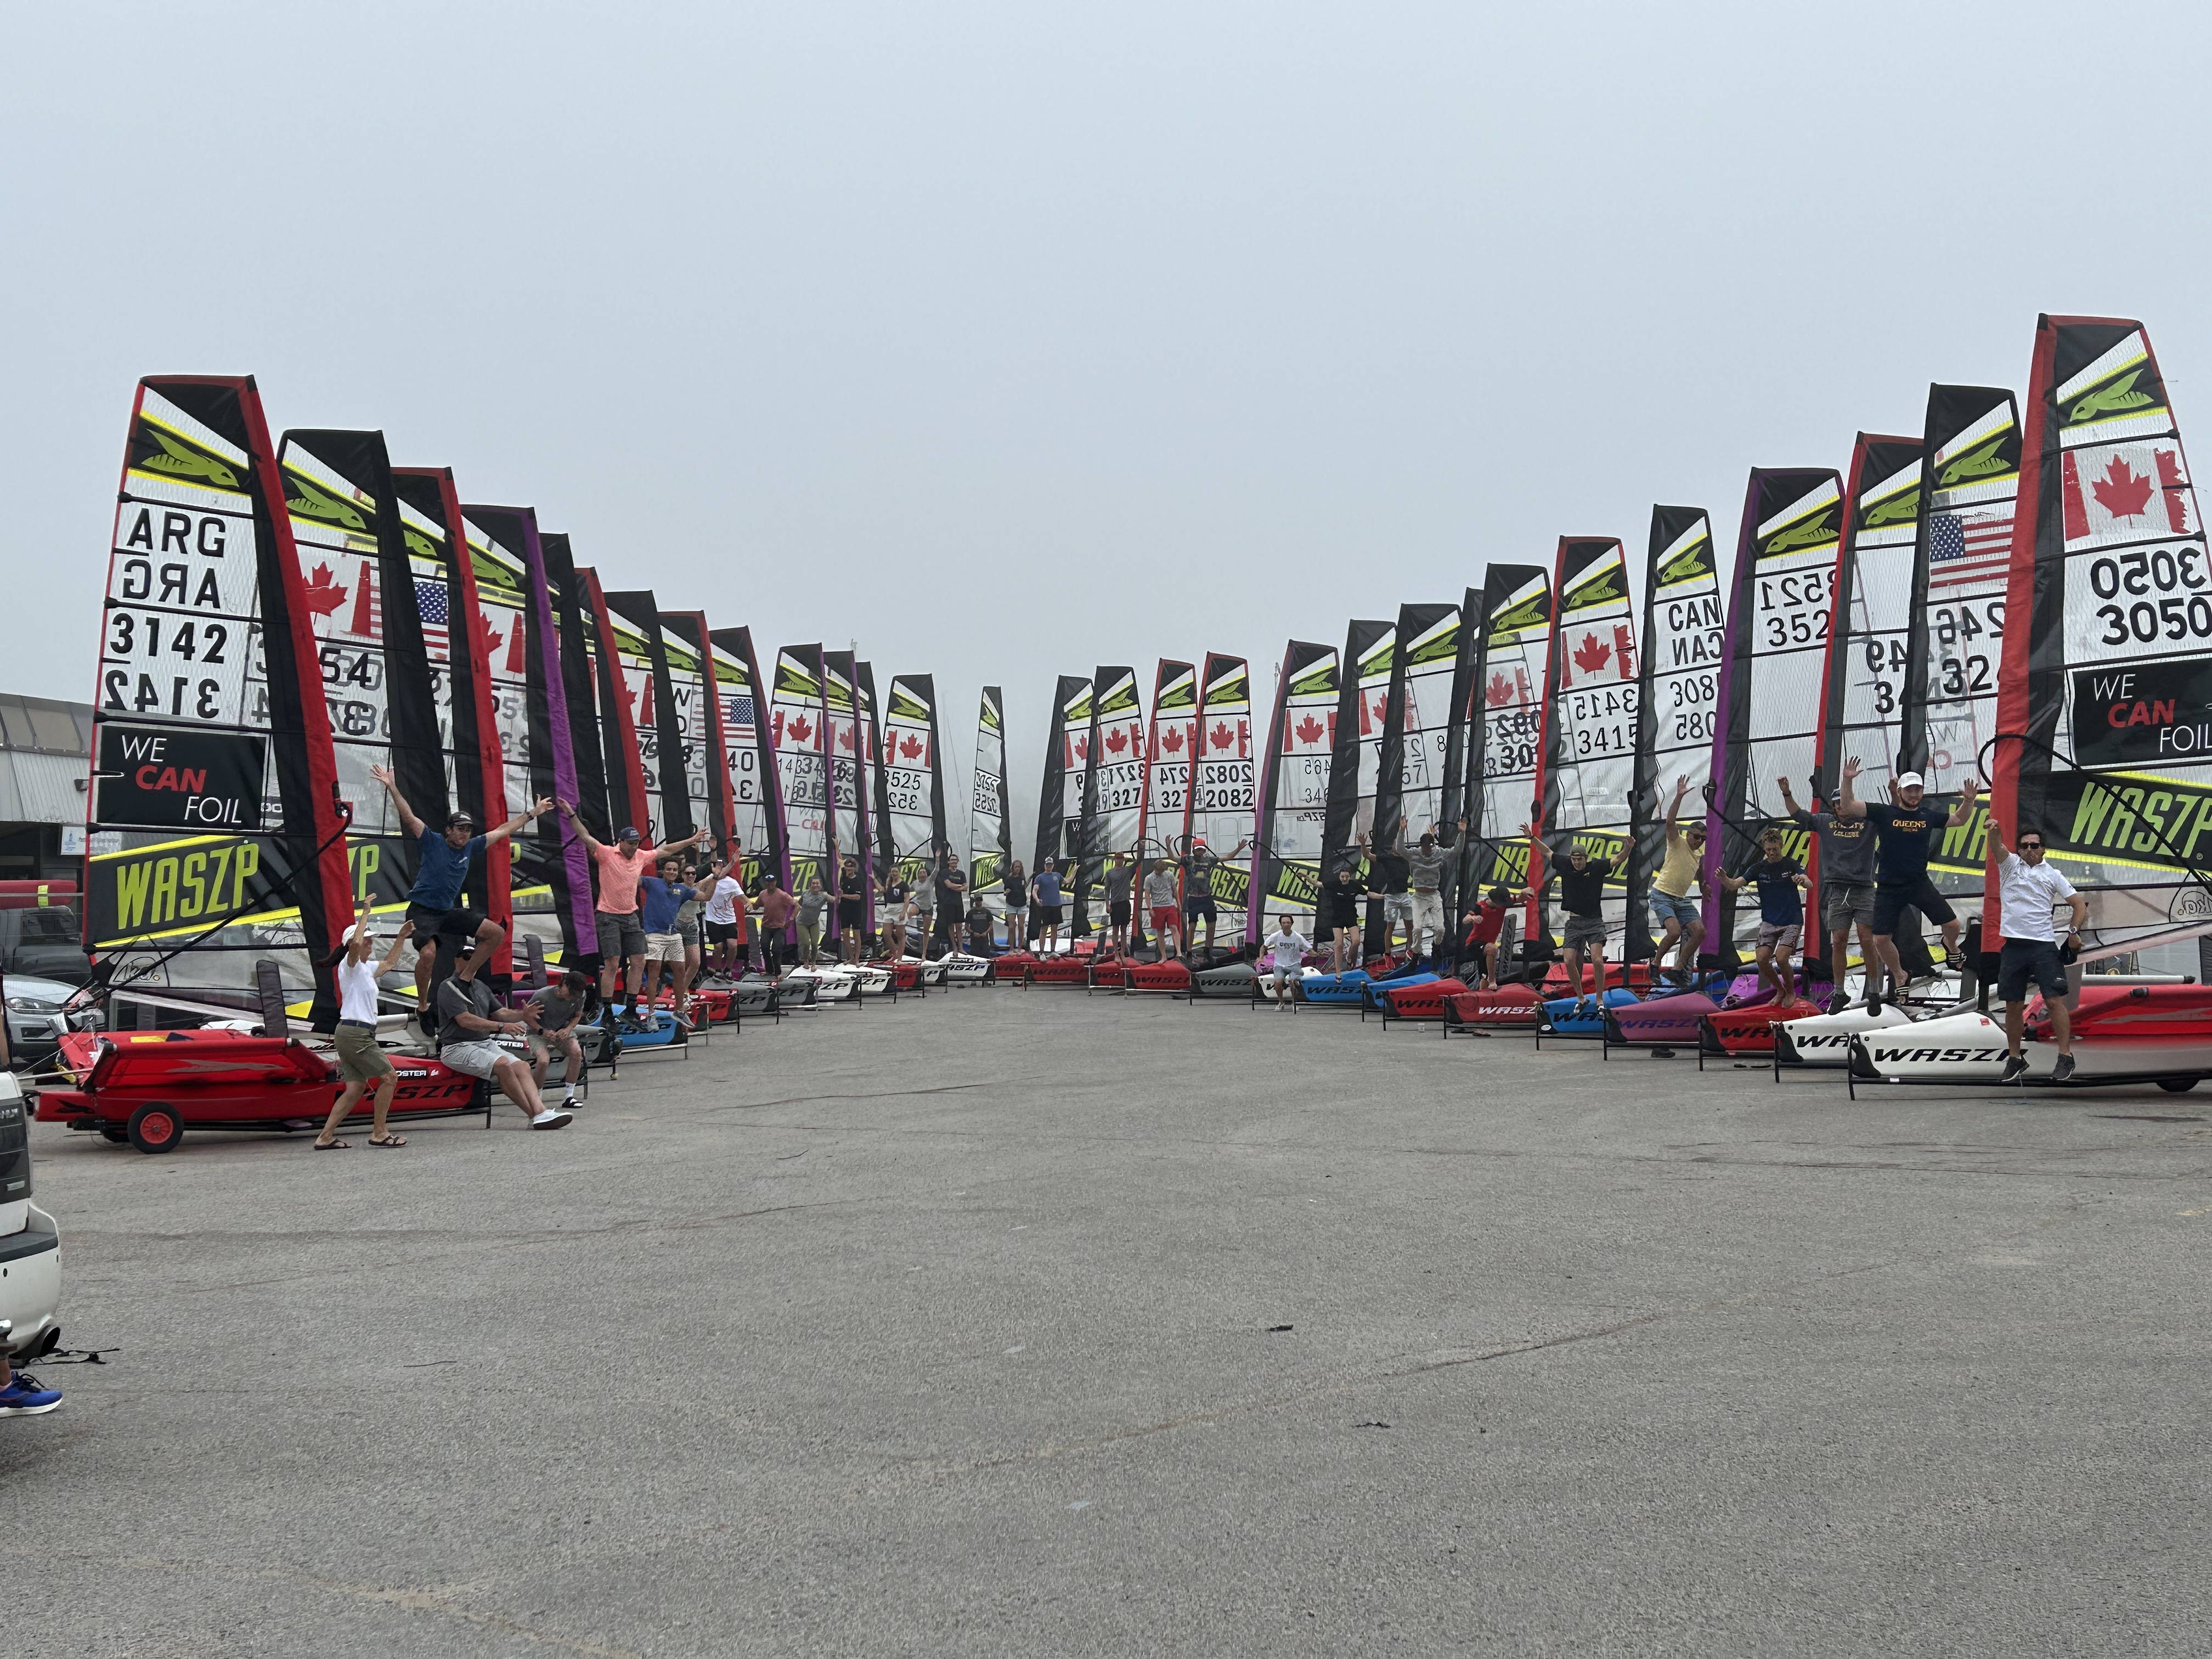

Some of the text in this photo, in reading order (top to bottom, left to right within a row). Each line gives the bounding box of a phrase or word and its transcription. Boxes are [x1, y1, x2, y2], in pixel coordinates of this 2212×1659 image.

[127, 508, 226, 558] ARG
[1668, 597, 1720, 631] CAN
[1767, 609, 1831, 647] 352
[2096, 596, 2212, 646] 3050
[110, 613, 227, 664] 3142
[1670, 674, 1715, 708] 308
[2094, 674, 2136, 701] WE
[2107, 698, 2176, 728] CAN
[121, 735, 167, 762] WE
[2159, 723, 2212, 753] FOIL
[135, 765, 207, 793] CAN
[184, 797, 241, 823] FOIL
[1112, 787, 1141, 807] 327
[1206, 788, 1254, 808] 2082
[2069, 781, 2212, 859] WASZP
[117, 843, 259, 930] WASZP
[1478, 1006, 1536, 1015] WASZ
